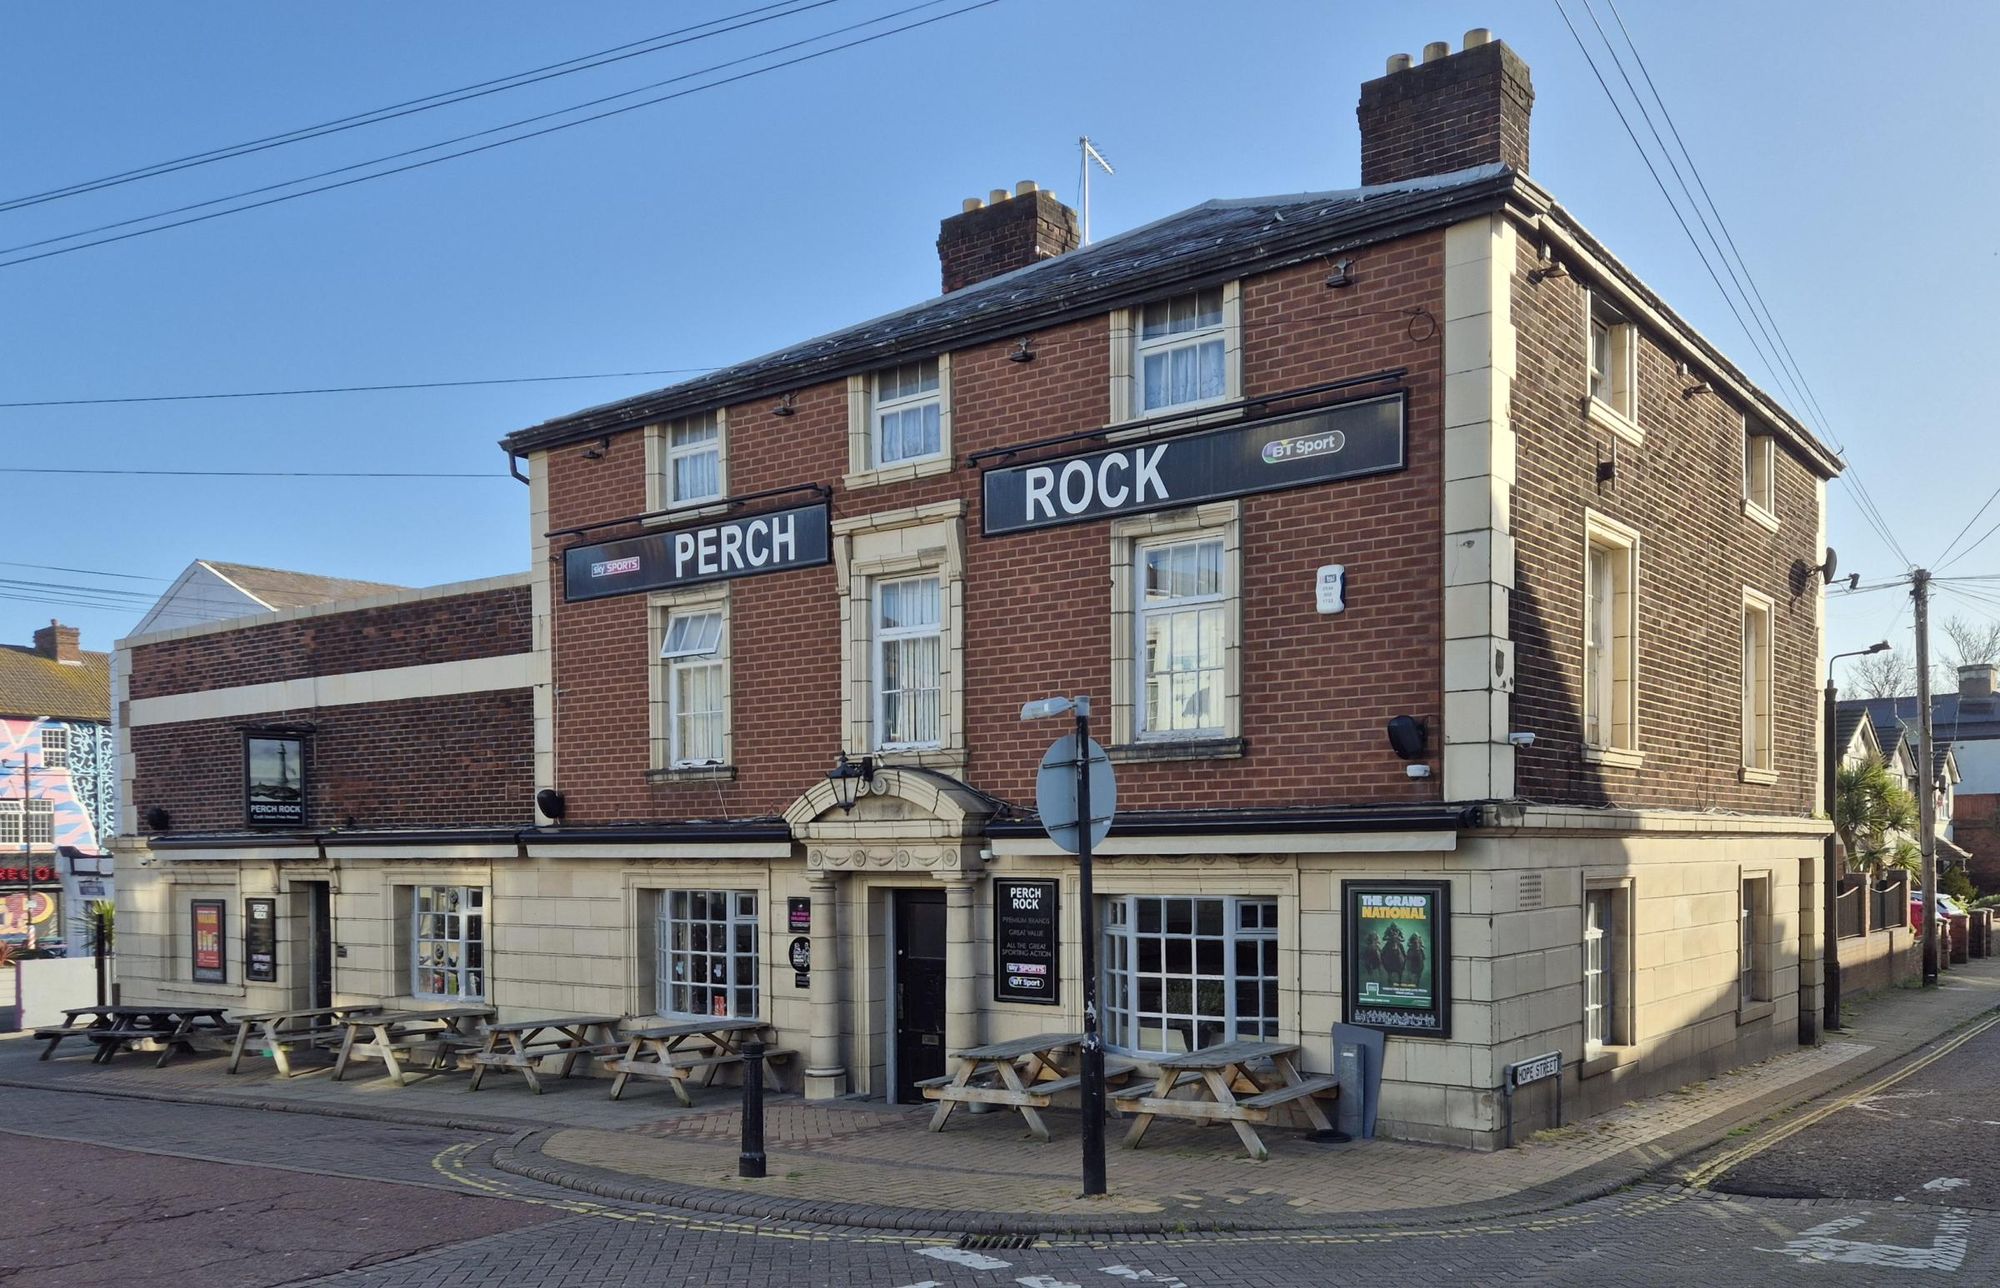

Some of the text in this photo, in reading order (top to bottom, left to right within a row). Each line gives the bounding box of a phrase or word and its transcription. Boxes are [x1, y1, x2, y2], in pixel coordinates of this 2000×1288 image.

[1272, 435, 1335, 458] BT Sport
[1026, 443, 1170, 521] ROCK
[675, 514, 795, 578] PERCH
[607, 559, 637, 572] SPORTS
[250, 804, 301, 813] PERCH ROCK
[1010, 887, 1041, 898] PERCH
[1013, 899, 1039, 909] ROCK
[1362, 895, 1426, 906] THE GRAND
[1362, 907, 1426, 919] NATIONAL
[1028, 917, 1050, 925] BRANDS
[1002, 948, 1029, 956] SPORTING
[1019, 965, 1044, 973] SPORTS
[1023, 979, 1040, 987] Sport
[1518, 1059, 1557, 1082] HOPE STREET
